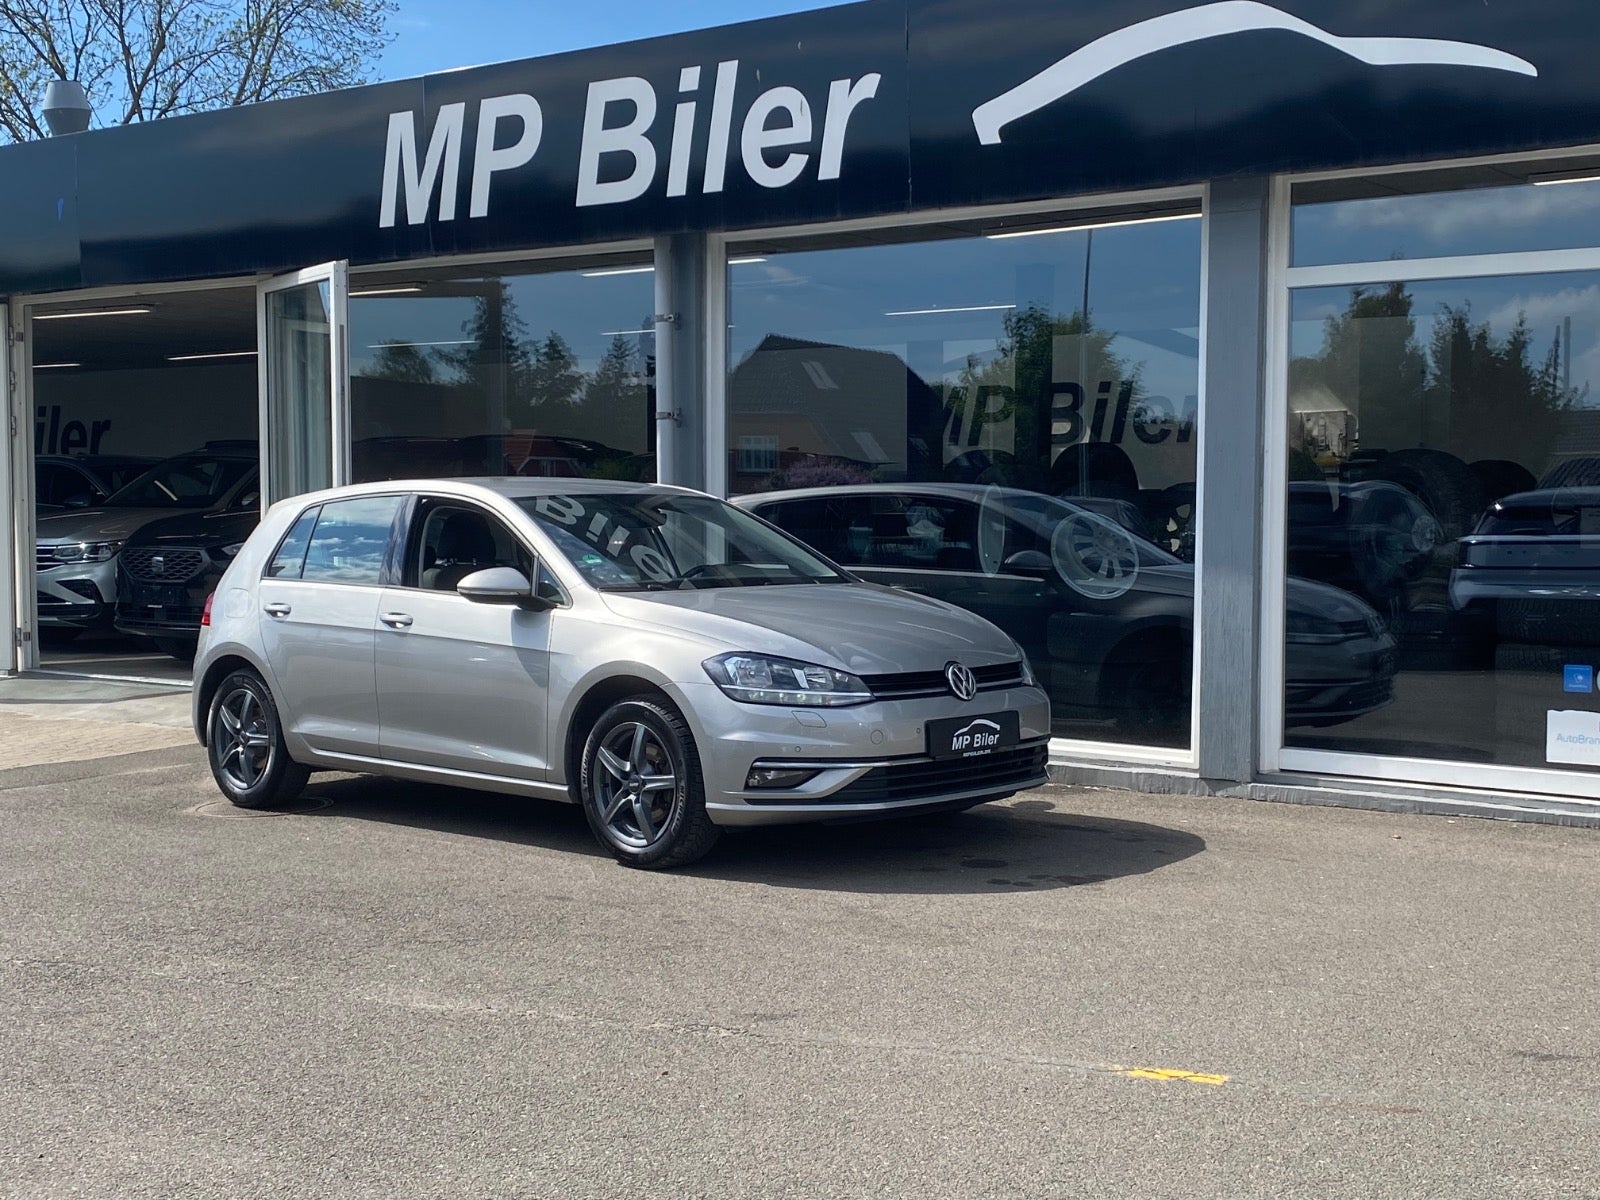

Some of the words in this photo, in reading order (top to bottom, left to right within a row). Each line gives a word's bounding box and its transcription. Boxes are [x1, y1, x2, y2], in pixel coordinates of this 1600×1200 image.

[379, 93, 543, 228] MP
[576, 59, 881, 207] Biler
[36, 405, 112, 455] iler
[951, 735, 970, 750] MP
[973, 732, 999, 747] Biler
[1556, 732, 1600, 745] AutoBran
